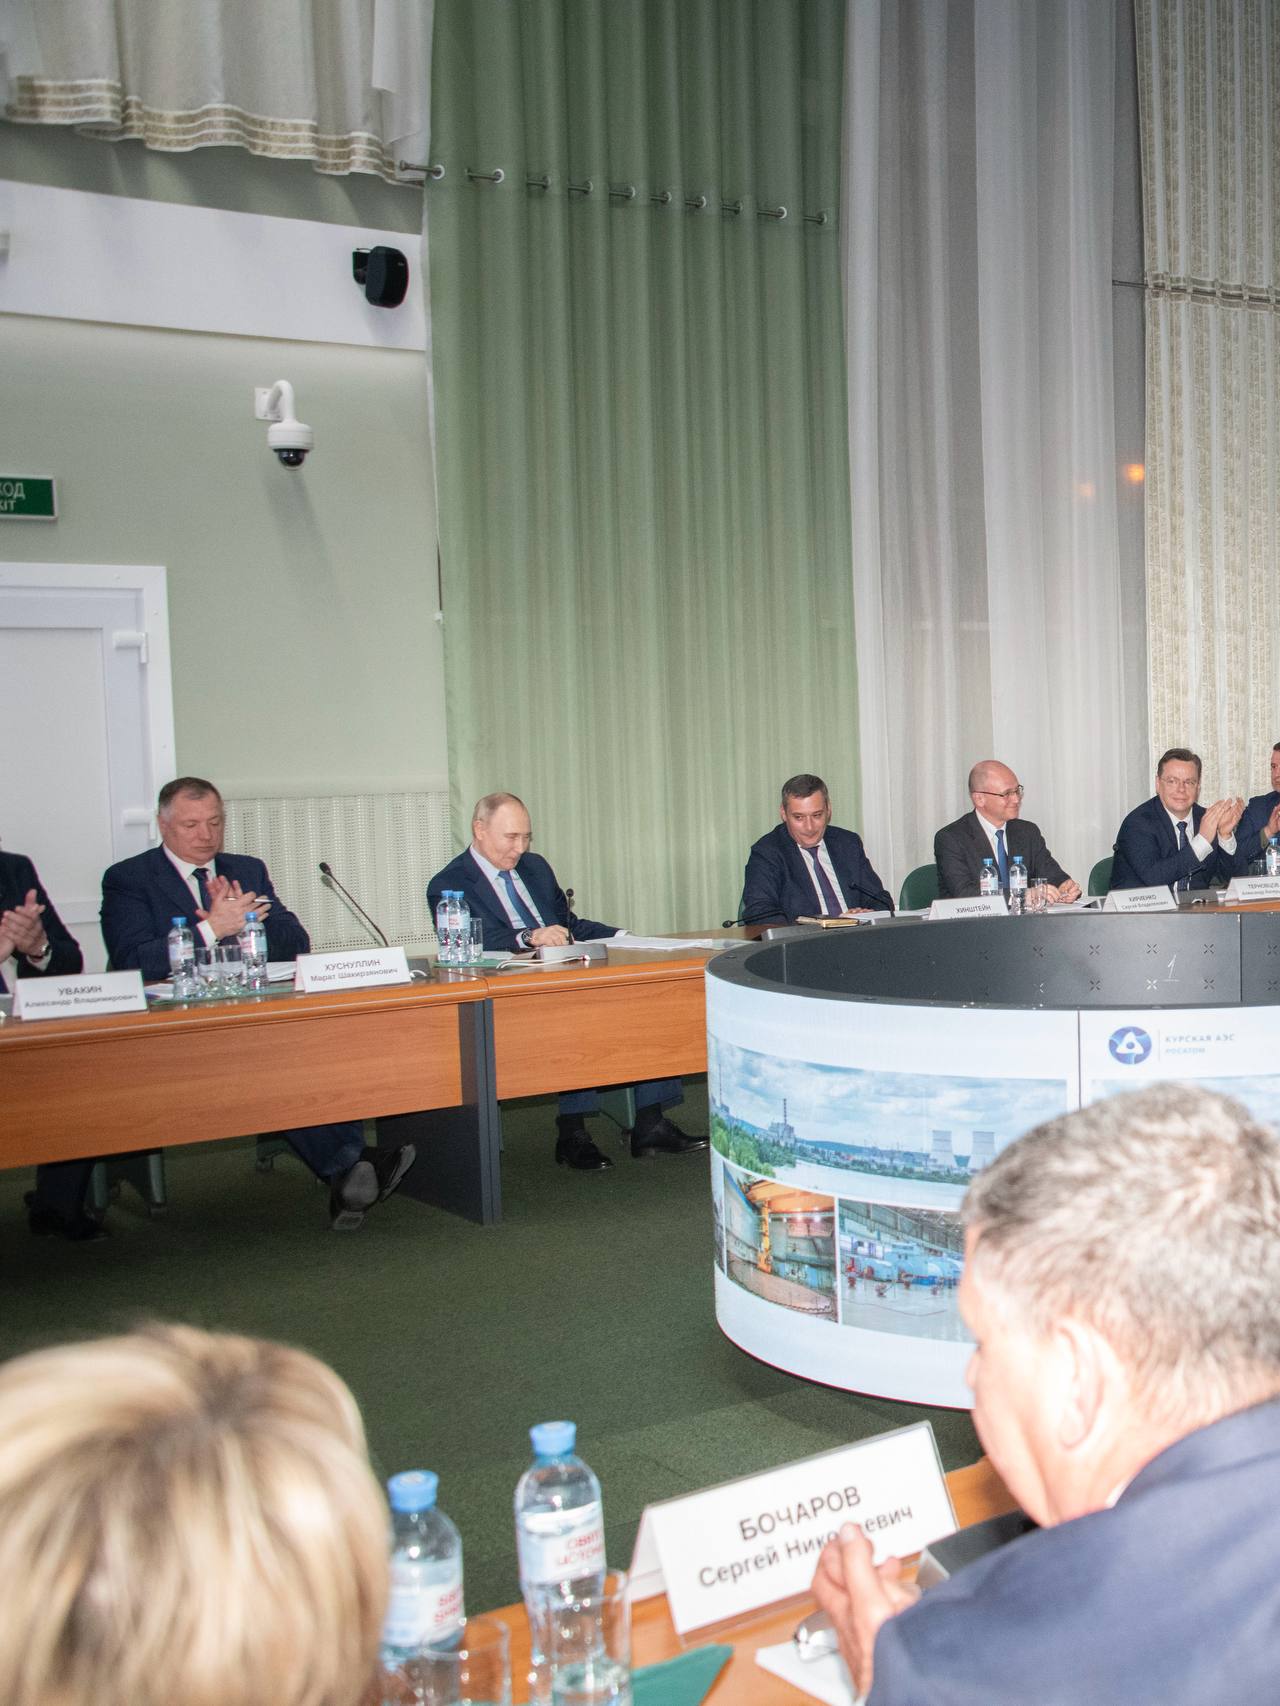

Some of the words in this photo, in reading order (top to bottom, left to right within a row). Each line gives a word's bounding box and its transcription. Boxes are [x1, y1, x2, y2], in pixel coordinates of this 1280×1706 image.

[325, 959, 381, 971] ХУСНУЛЛИН
[310, 974, 336, 982] Марат
[58, 985, 102, 996] УВАКИН
[24, 1000, 73, 1008] Александр
[73, 994, 138, 1004] Владимирович
[1215, 1032, 1236, 1041] АЭС
[739, 1486, 862, 1541] БОЧАРОВ
[699, 1547, 780, 1588] Сергей
[785, 1505, 914, 1559] Никоевич
